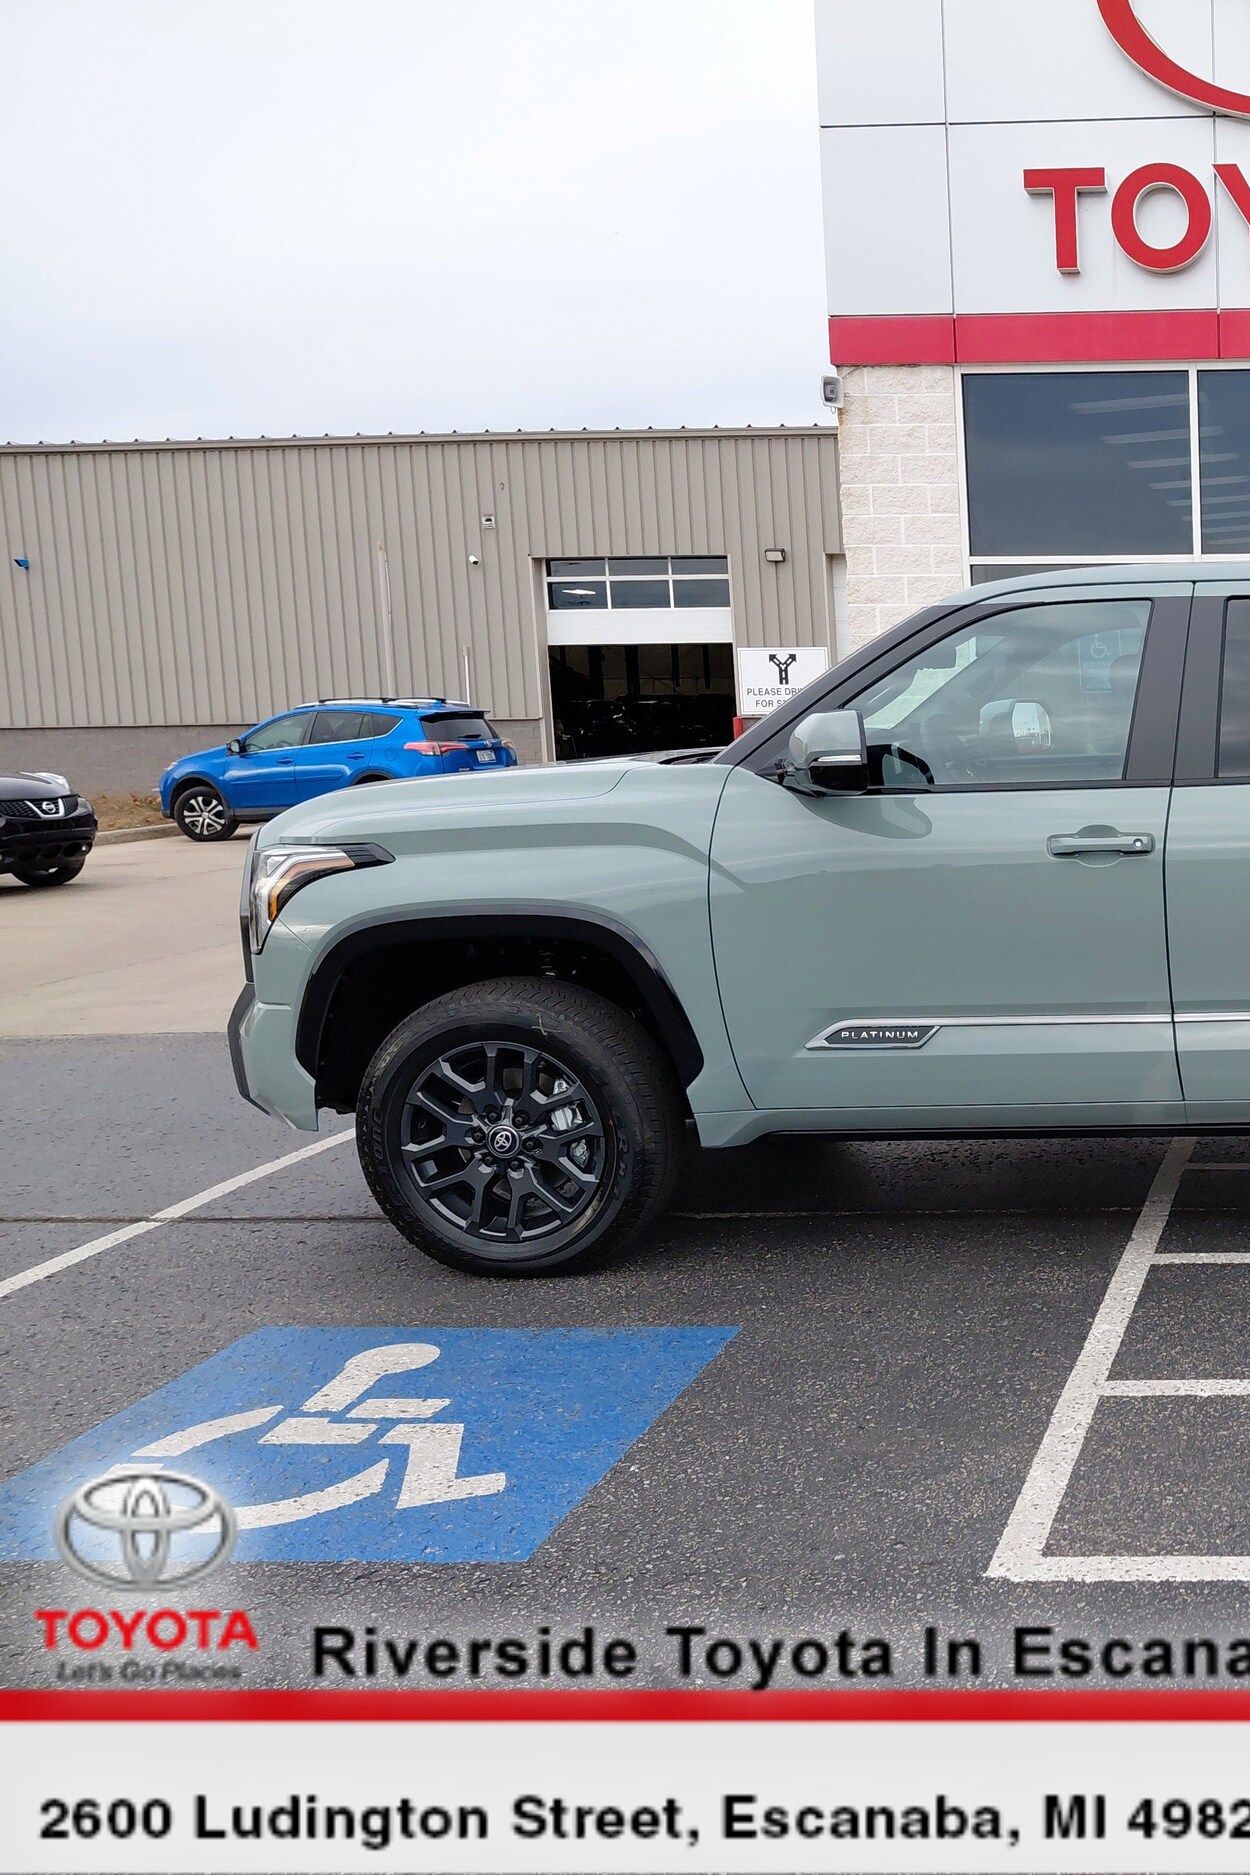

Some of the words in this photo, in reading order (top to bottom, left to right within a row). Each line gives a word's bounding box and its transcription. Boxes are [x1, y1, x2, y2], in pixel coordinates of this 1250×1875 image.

[746, 687, 782, 696] PLEASE
[755, 699, 774, 708] FOR
[841, 1030, 919, 1039] PLATINUM
